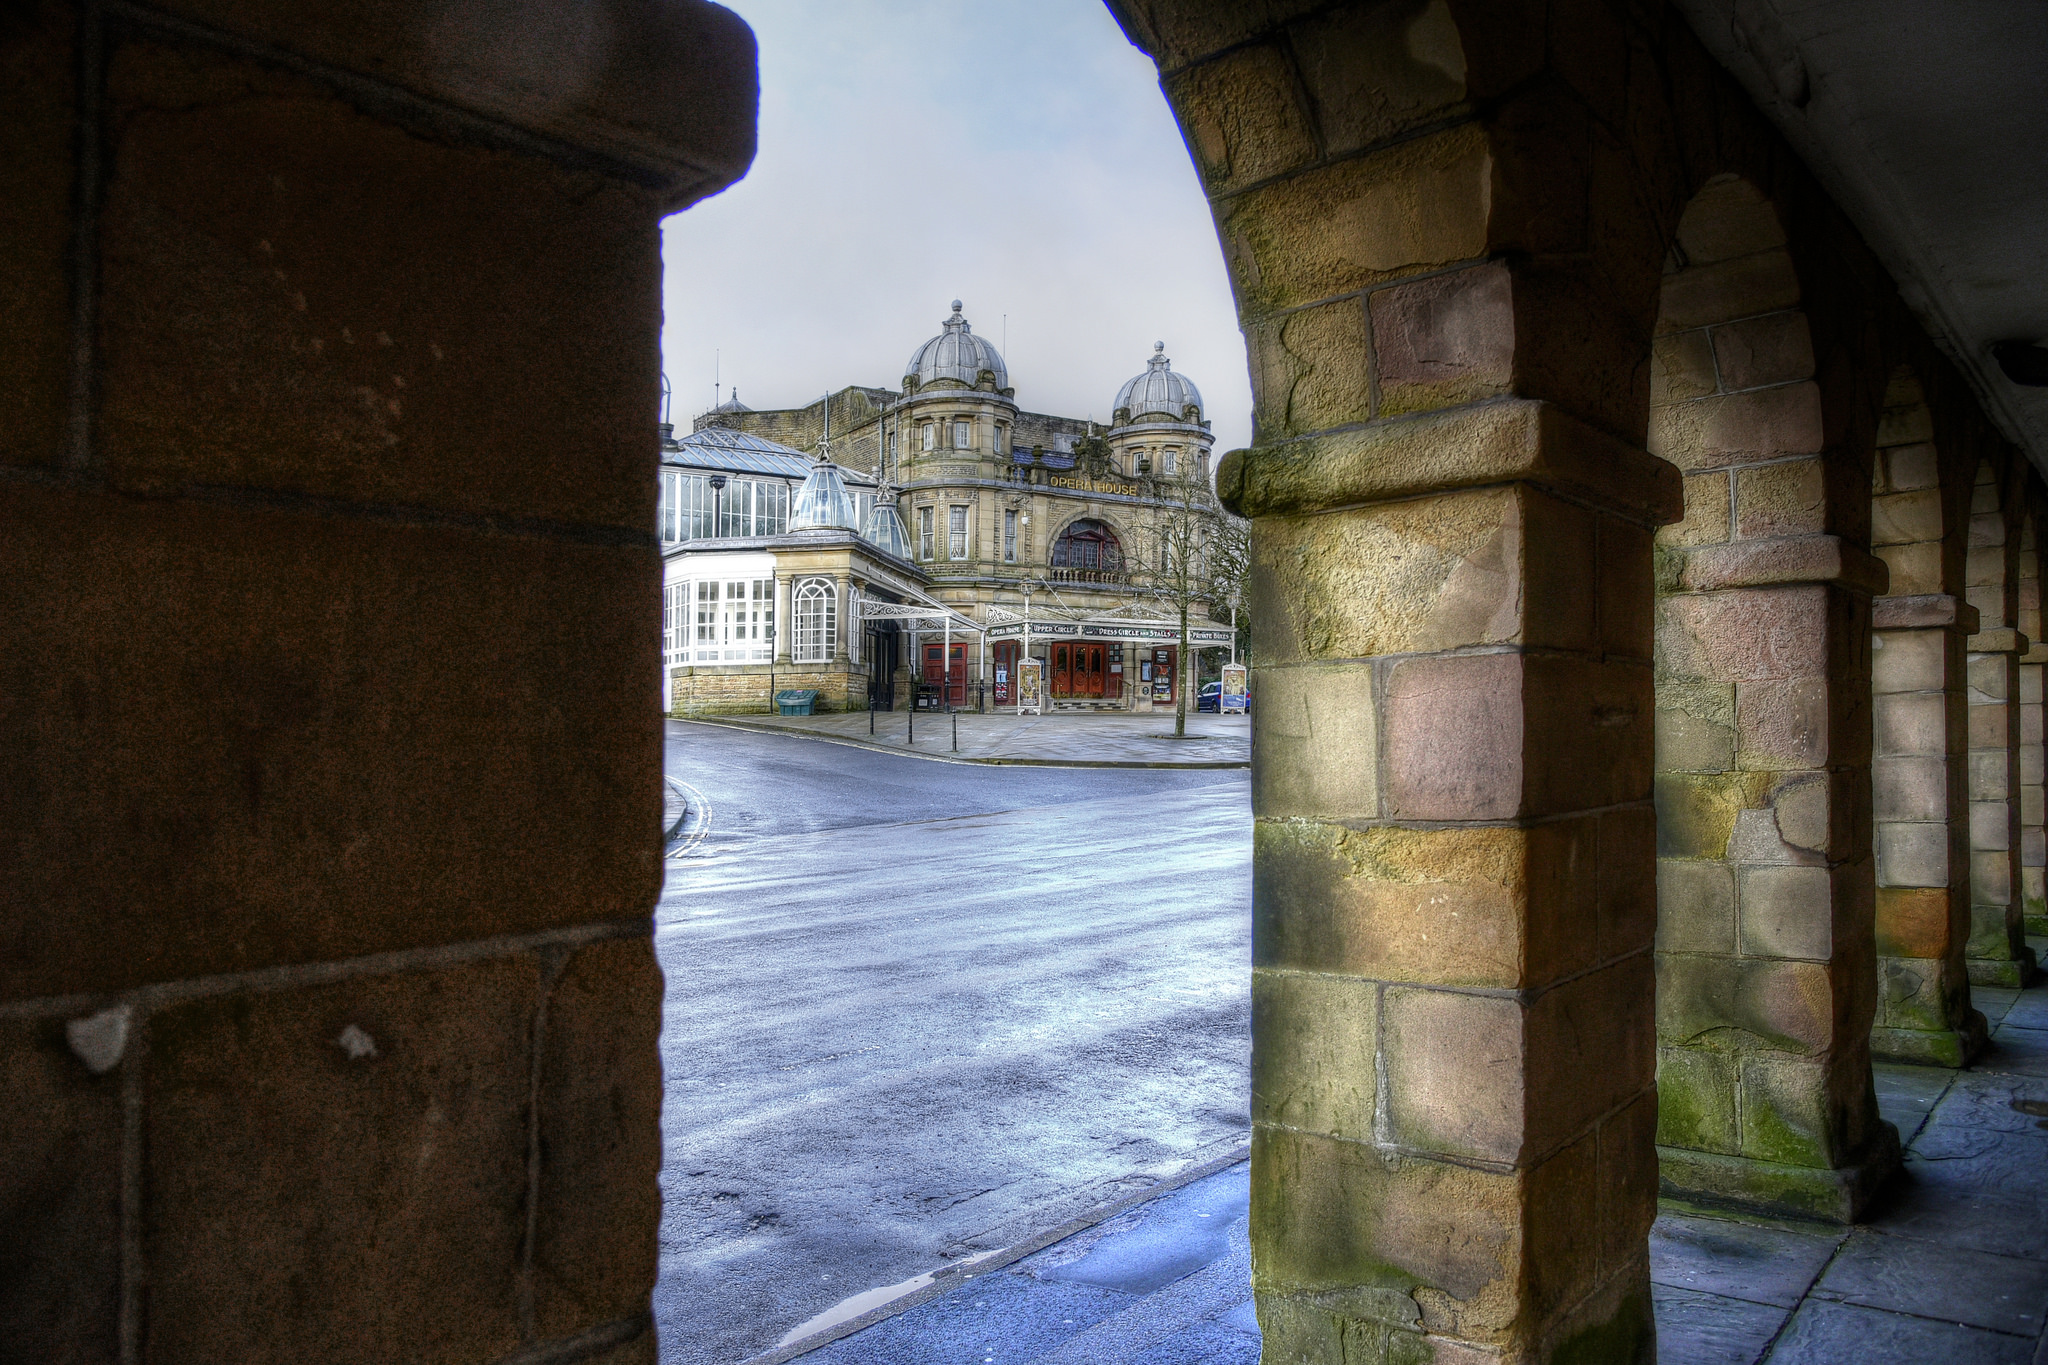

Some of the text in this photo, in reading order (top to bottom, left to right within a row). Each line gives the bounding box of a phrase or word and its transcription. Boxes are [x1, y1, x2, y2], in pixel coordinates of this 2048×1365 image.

[1050, 476, 1137, 496] OPERA HOUSE
[1099, 627, 1117, 635] DRESS
[1118, 628, 1140, 636] CIRCLE
[1149, 629, 1171, 637] STALLS
